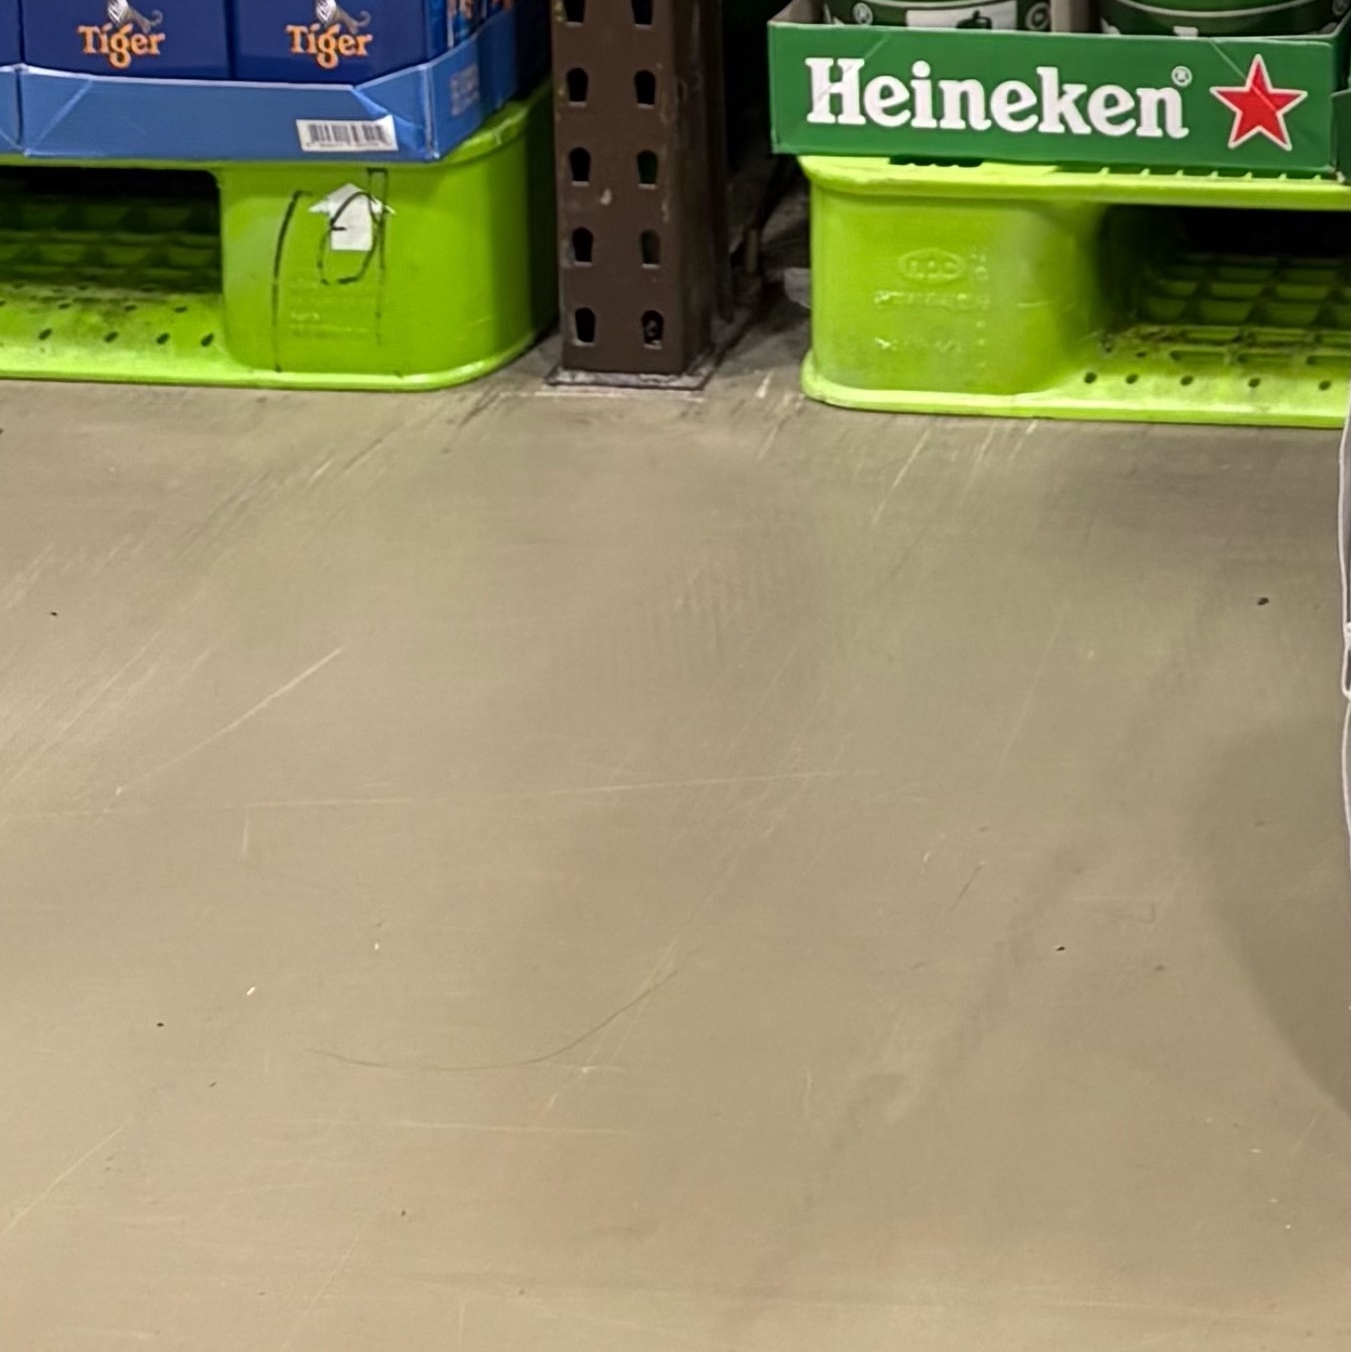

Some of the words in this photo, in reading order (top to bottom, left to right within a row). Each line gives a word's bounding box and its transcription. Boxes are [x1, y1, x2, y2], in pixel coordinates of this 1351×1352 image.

[77, 24, 165, 68] Tiger
[284, 23, 372, 68] Tiger
[805, 57, 1188, 138] Heineken
